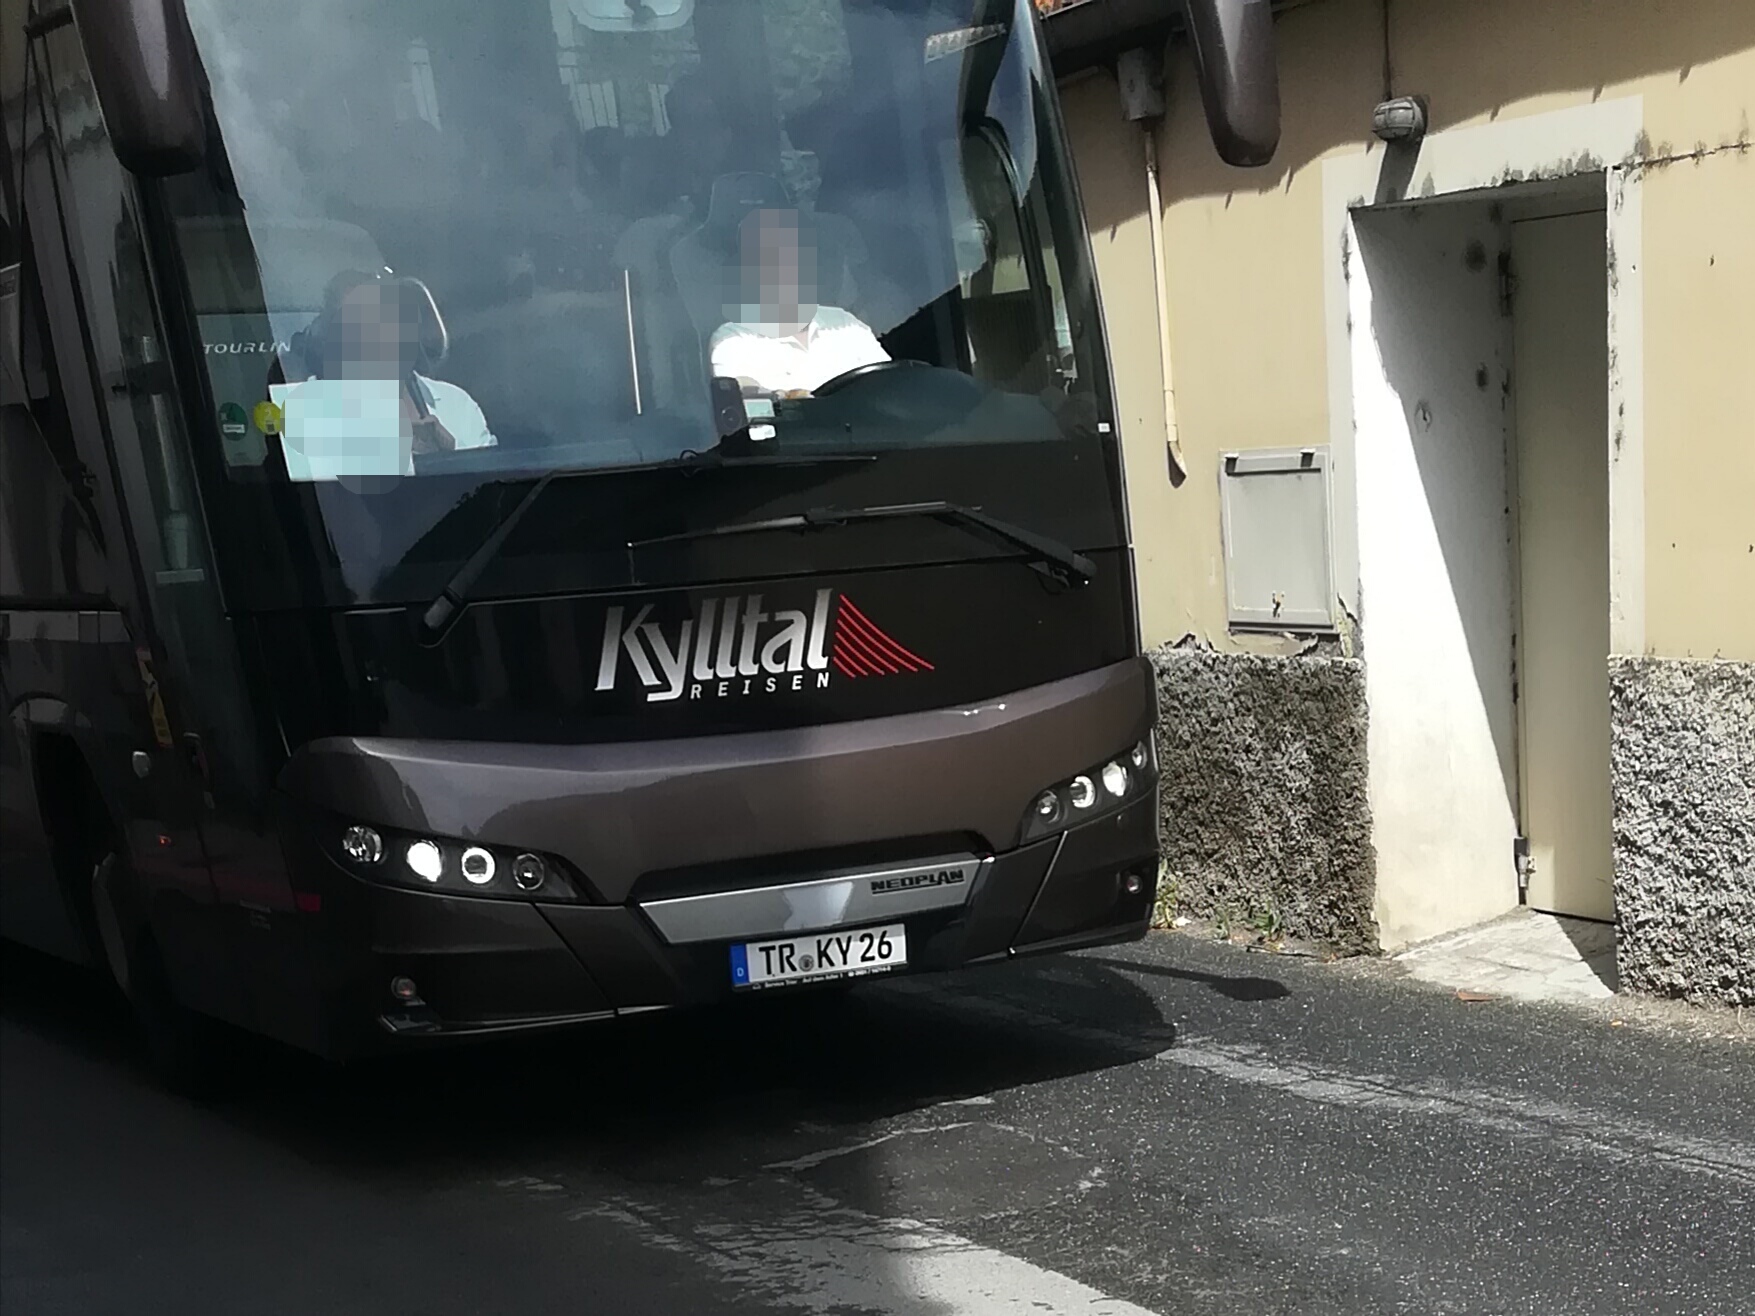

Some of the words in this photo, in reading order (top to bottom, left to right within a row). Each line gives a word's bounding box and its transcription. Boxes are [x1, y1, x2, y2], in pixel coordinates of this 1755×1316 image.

[594, 588, 833, 702] Kylltal
[690, 672, 830, 700] REISEN
[870, 869, 965, 893] NEOPLAN
[758, 942, 798, 975] TR
[816, 935, 852, 969] KY
[859, 930, 893, 963] 26
[736, 967, 745, 977] D
